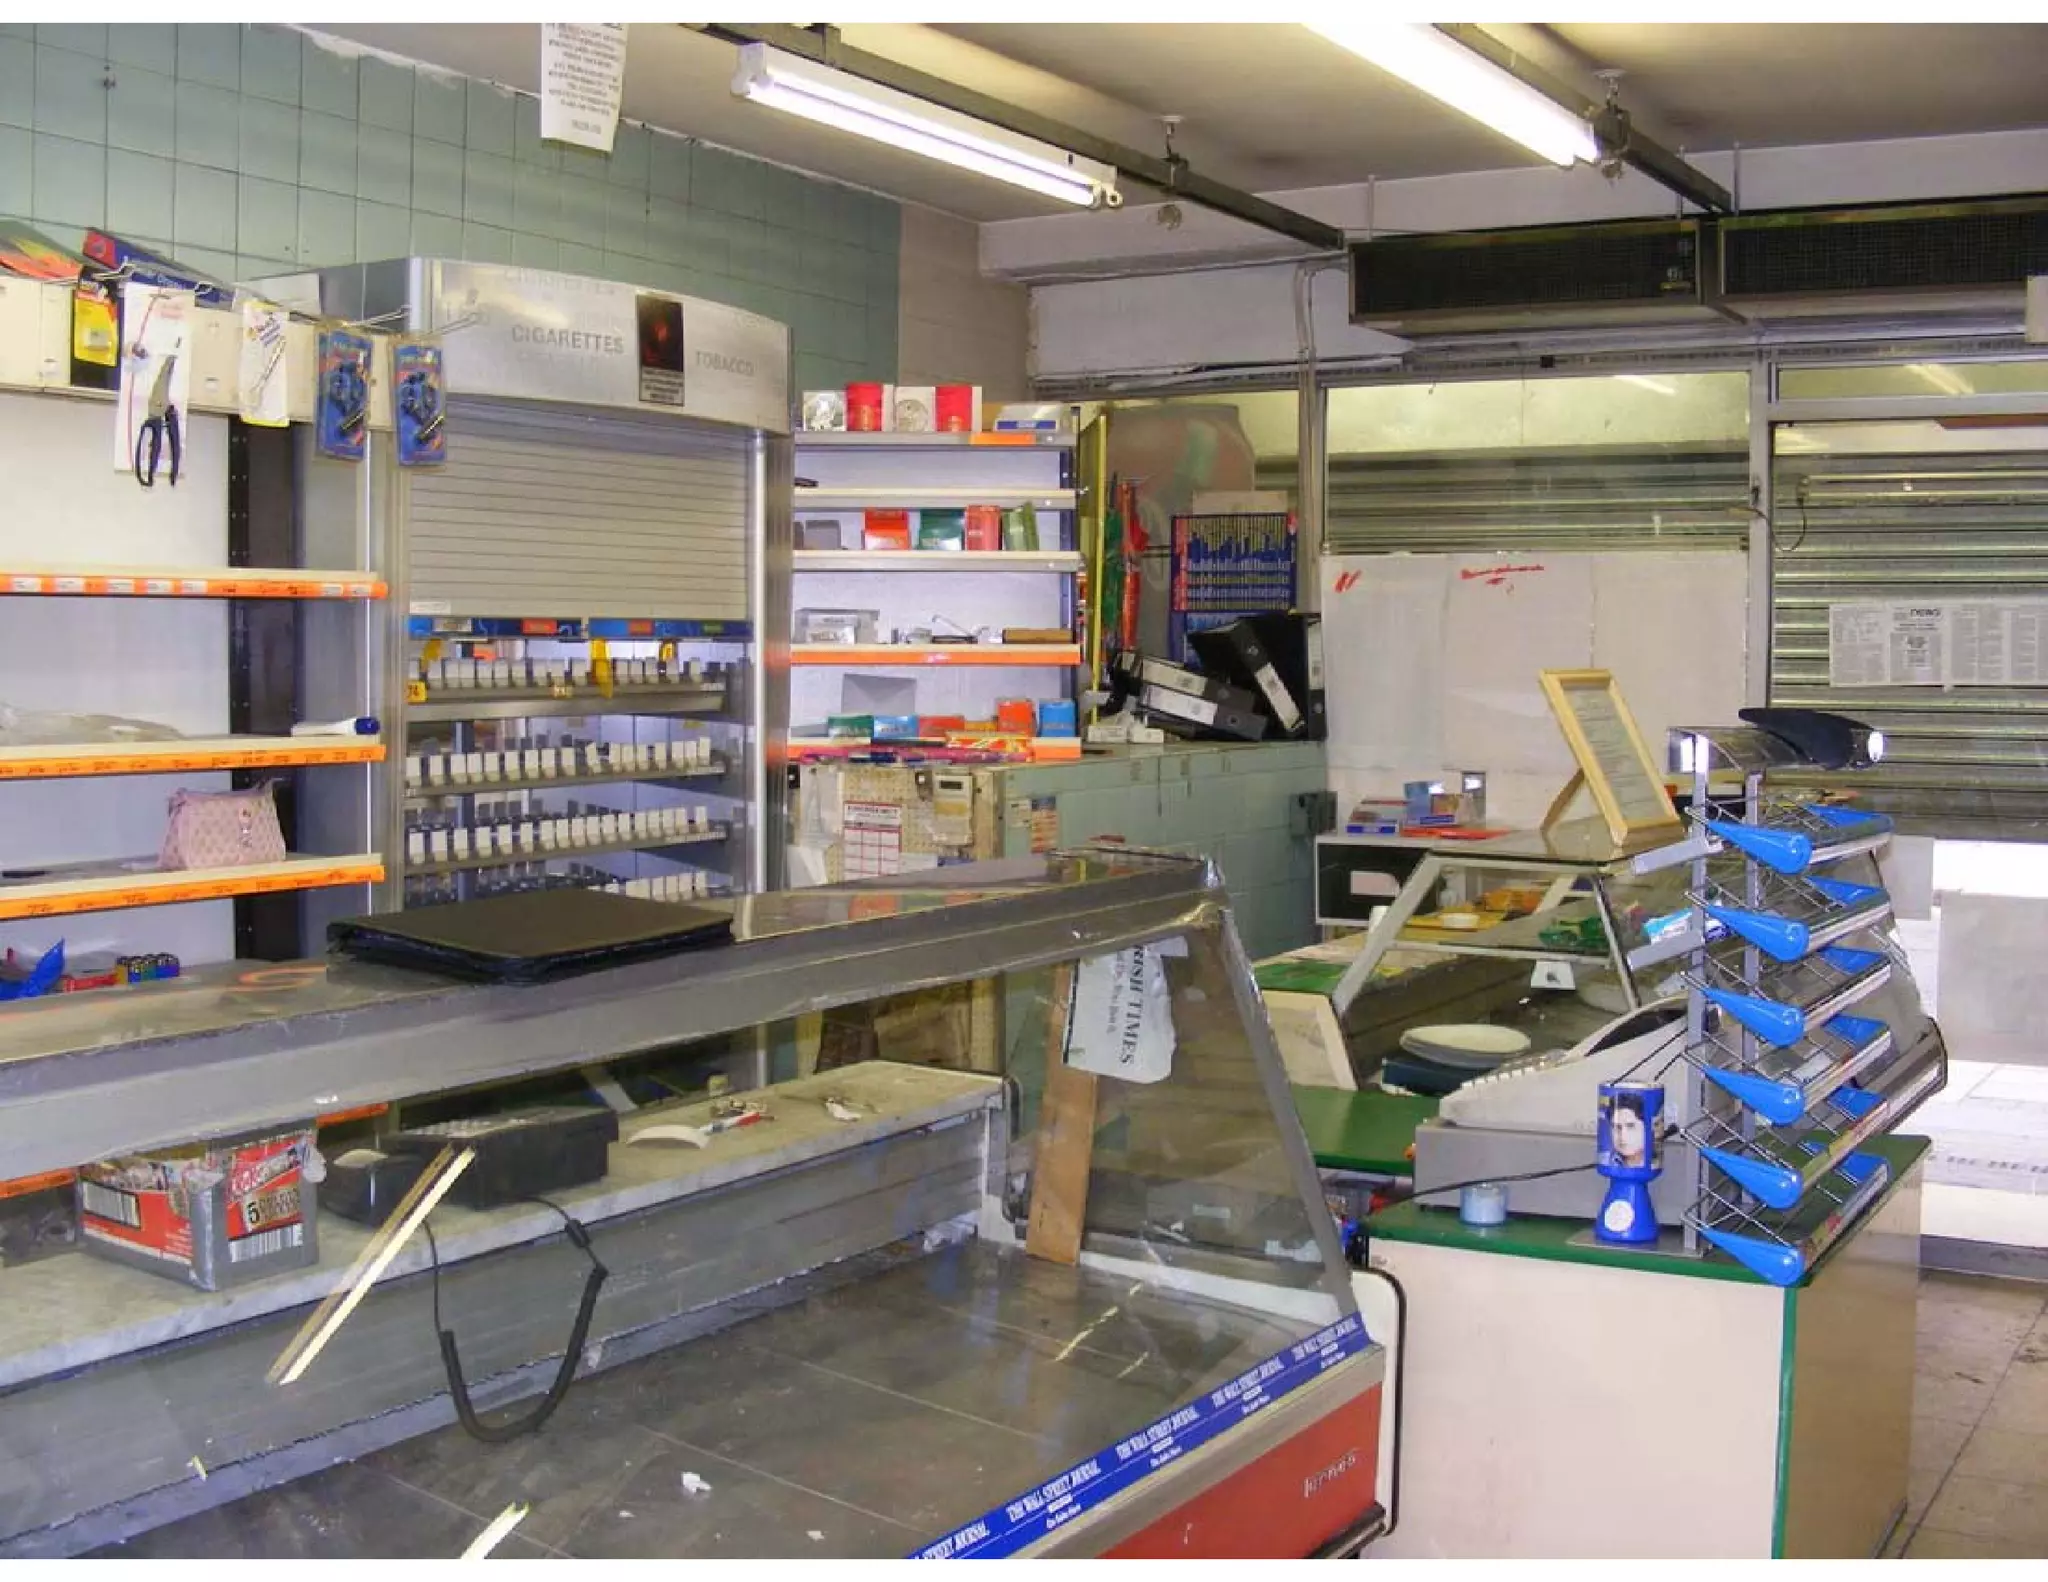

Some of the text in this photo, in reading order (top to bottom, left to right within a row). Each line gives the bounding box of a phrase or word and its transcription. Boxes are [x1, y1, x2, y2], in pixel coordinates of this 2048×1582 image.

[511, 324, 624, 354] CIGARETTES
[695, 350, 755, 377] TOBACCO
[1120, 945, 1144, 1064] RISH TIMES
